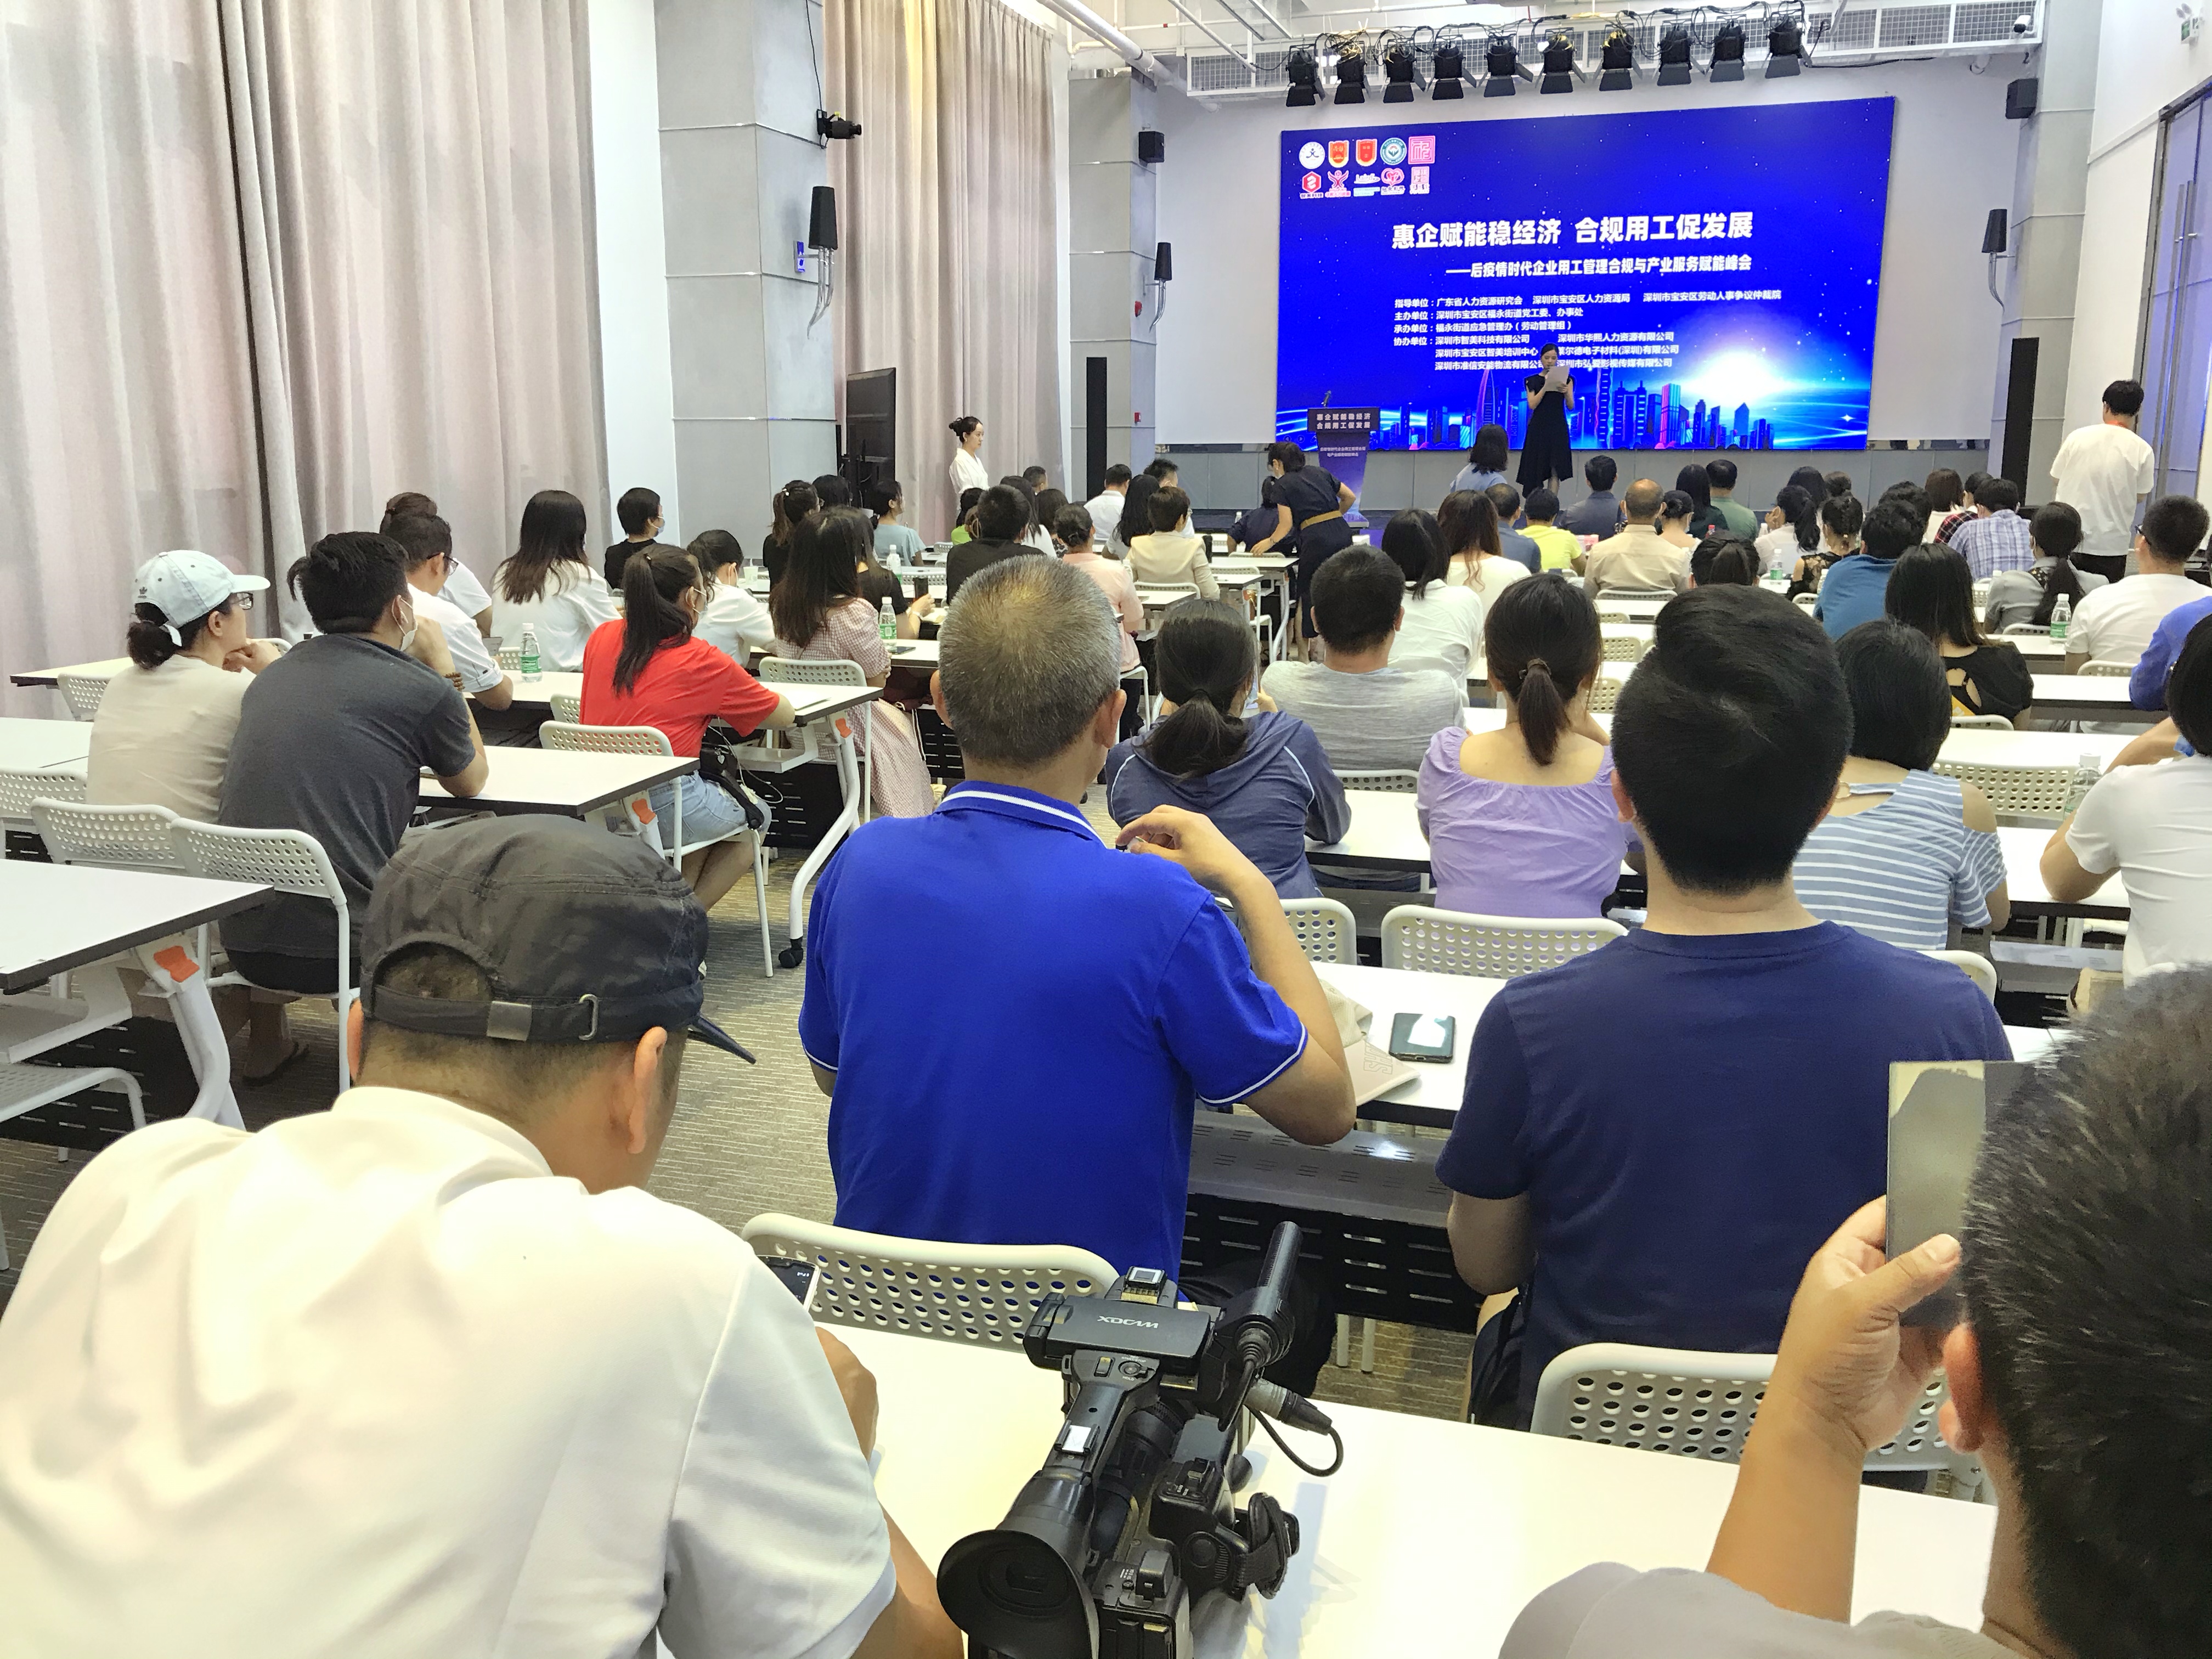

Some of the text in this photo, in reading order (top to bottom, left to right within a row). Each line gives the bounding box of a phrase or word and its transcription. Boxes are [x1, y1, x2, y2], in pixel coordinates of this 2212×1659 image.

[1392, 212, 1753, 249] 惠企赋能稳经济 合规用工促发展
[1532, 294, 1630, 304] 深圳市宝安区人力资源局
[1643, 290, 1782, 302] 深圳市宝安区劳动人事争议仲裁院
[1435, 347, 1538, 358] 深圳市宝安区智美培训中心
[1097, 1316, 1159, 1328] XDCAM
